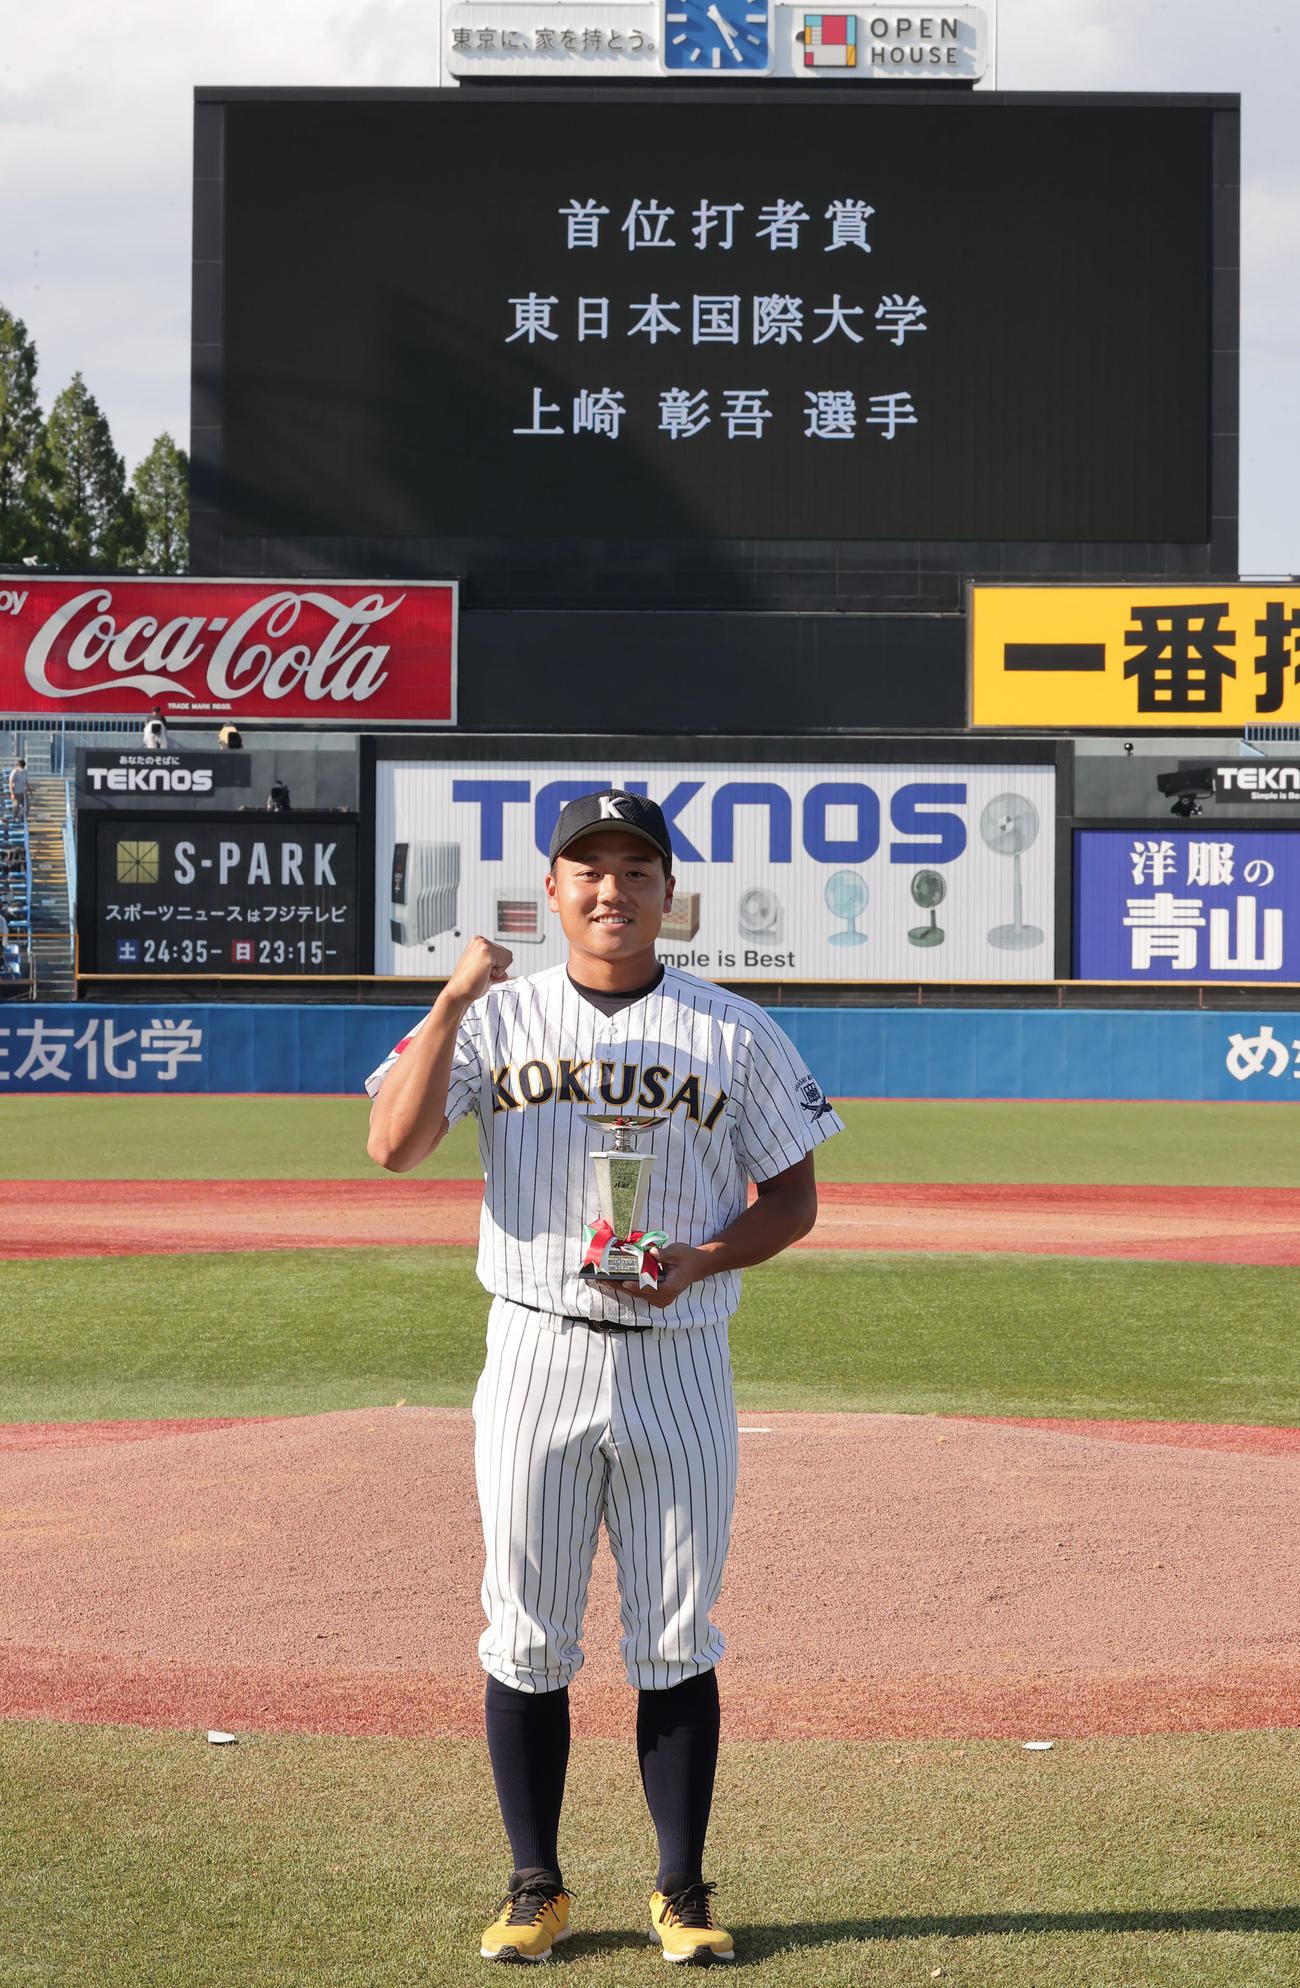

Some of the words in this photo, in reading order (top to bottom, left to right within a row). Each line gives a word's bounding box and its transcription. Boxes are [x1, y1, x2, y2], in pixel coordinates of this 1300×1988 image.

[451, 27, 657, 52] 東京に、家を持とう。
[870, 17, 960, 38] OPEN
[871, 47, 958, 64] HOUSE
[558, 198, 876, 253] 首位打者賞
[504, 292, 928, 346] 東日本国際大学
[512, 387, 627, 439] 上崎
[657, 387, 773, 440] 彰吾
[803, 390, 918, 440] 選手
[24, 589, 407, 701] Coca-Cola
[168, 702, 190, 710] TRADE
[191, 702, 211, 710] MARK
[119, 756, 181, 766] あなたのそばに
[598, 795, 627, 819] K
[1251, 791, 1279, 801] Simple
[174, 841, 337, 886] S-PARK
[1130, 840, 1275, 887] 洋服の
[105, 903, 348, 923] スポーツニュースはフジテレビ
[1122, 893, 1284, 971] 青山
[119, 942, 136, 961] 土
[235, 942, 251, 961] 日
[718, 950, 736, 967] is
[744, 950, 796, 967] Best
[0, 1018, 202, 1081] 友化学
[1226, 1026, 1300, 1081] め
[490, 1058, 728, 1132] KOKUSAI
